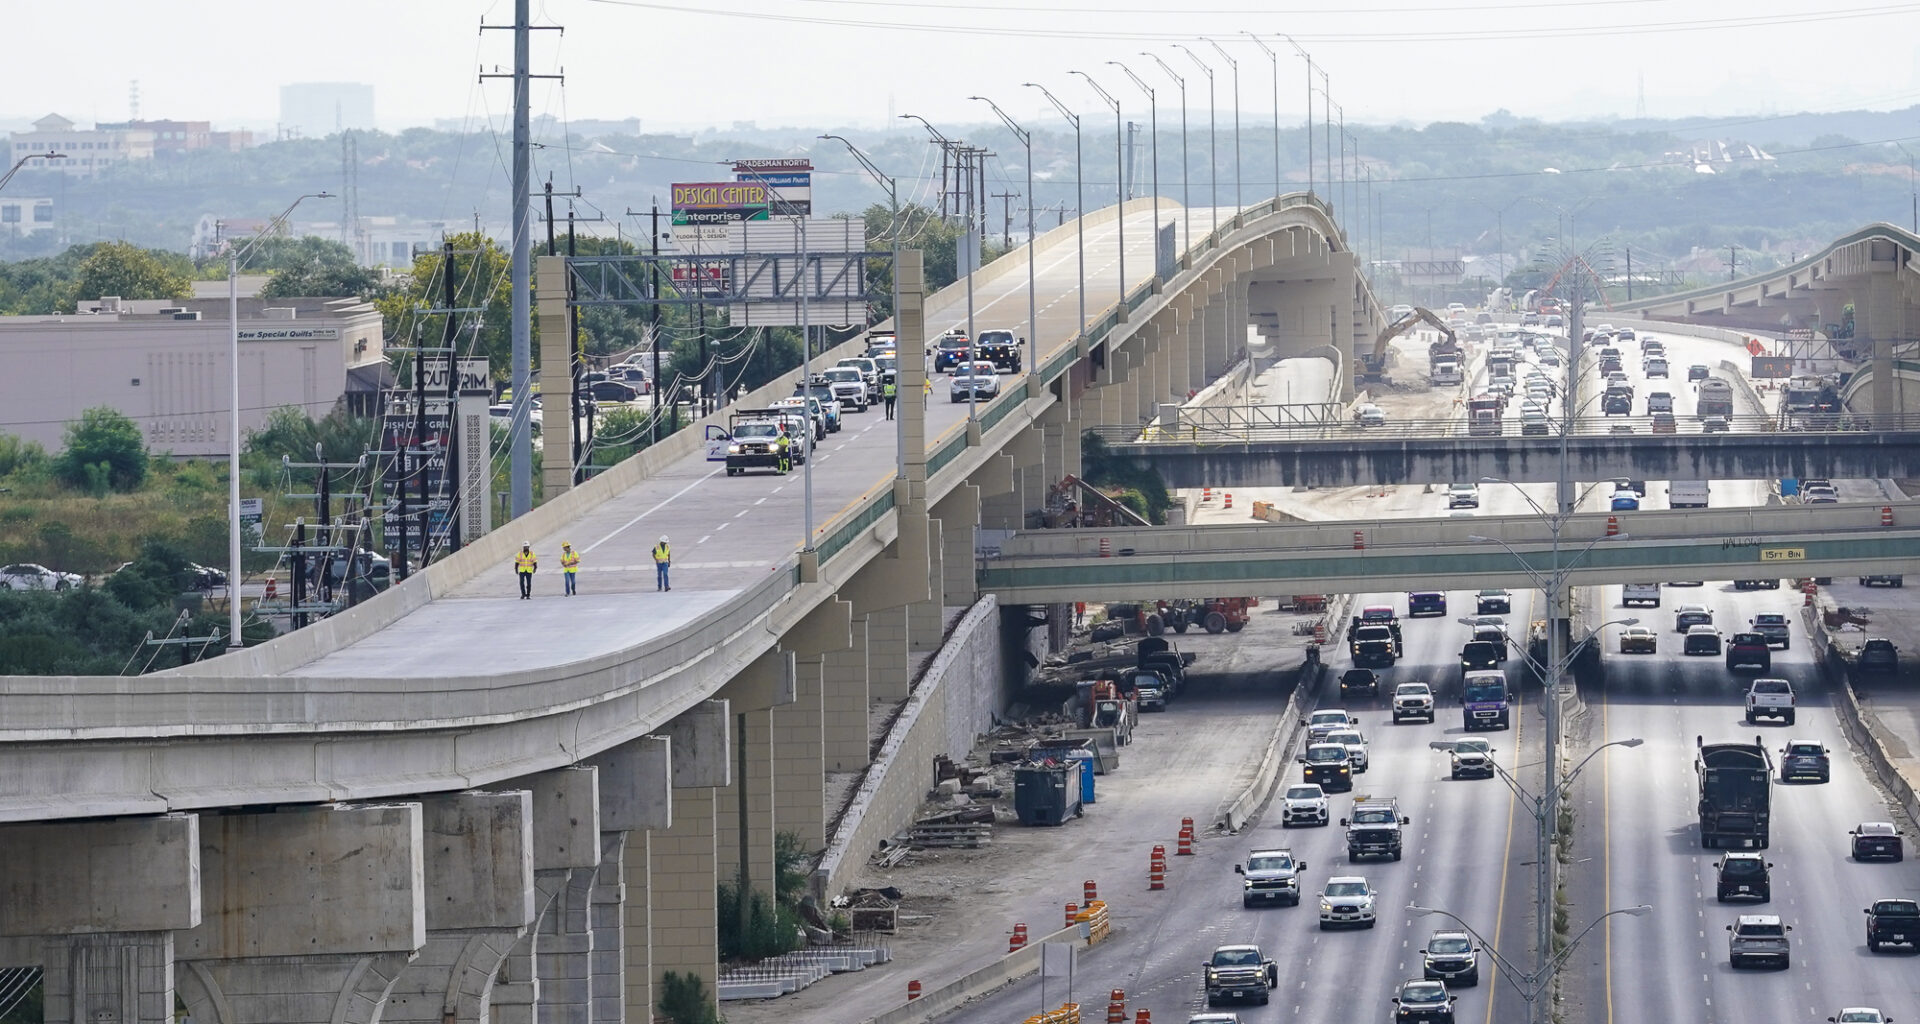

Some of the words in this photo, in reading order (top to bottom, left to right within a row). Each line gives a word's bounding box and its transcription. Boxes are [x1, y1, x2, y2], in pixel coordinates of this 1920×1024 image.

[738, 160, 782, 168] TRADESMAN
[783, 159, 809, 167] NORTH
[675, 188, 718, 205] DESIGN
[721, 187, 765, 204] CENTER
[238, 331, 255, 339] Sew
[257, 330, 288, 339] Special
[289, 330, 313, 338] Quilts
[384, 421, 405, 429] FISH
[1765, 551, 1783, 559] 15FT
[1787, 550, 1801, 558] 8IN
